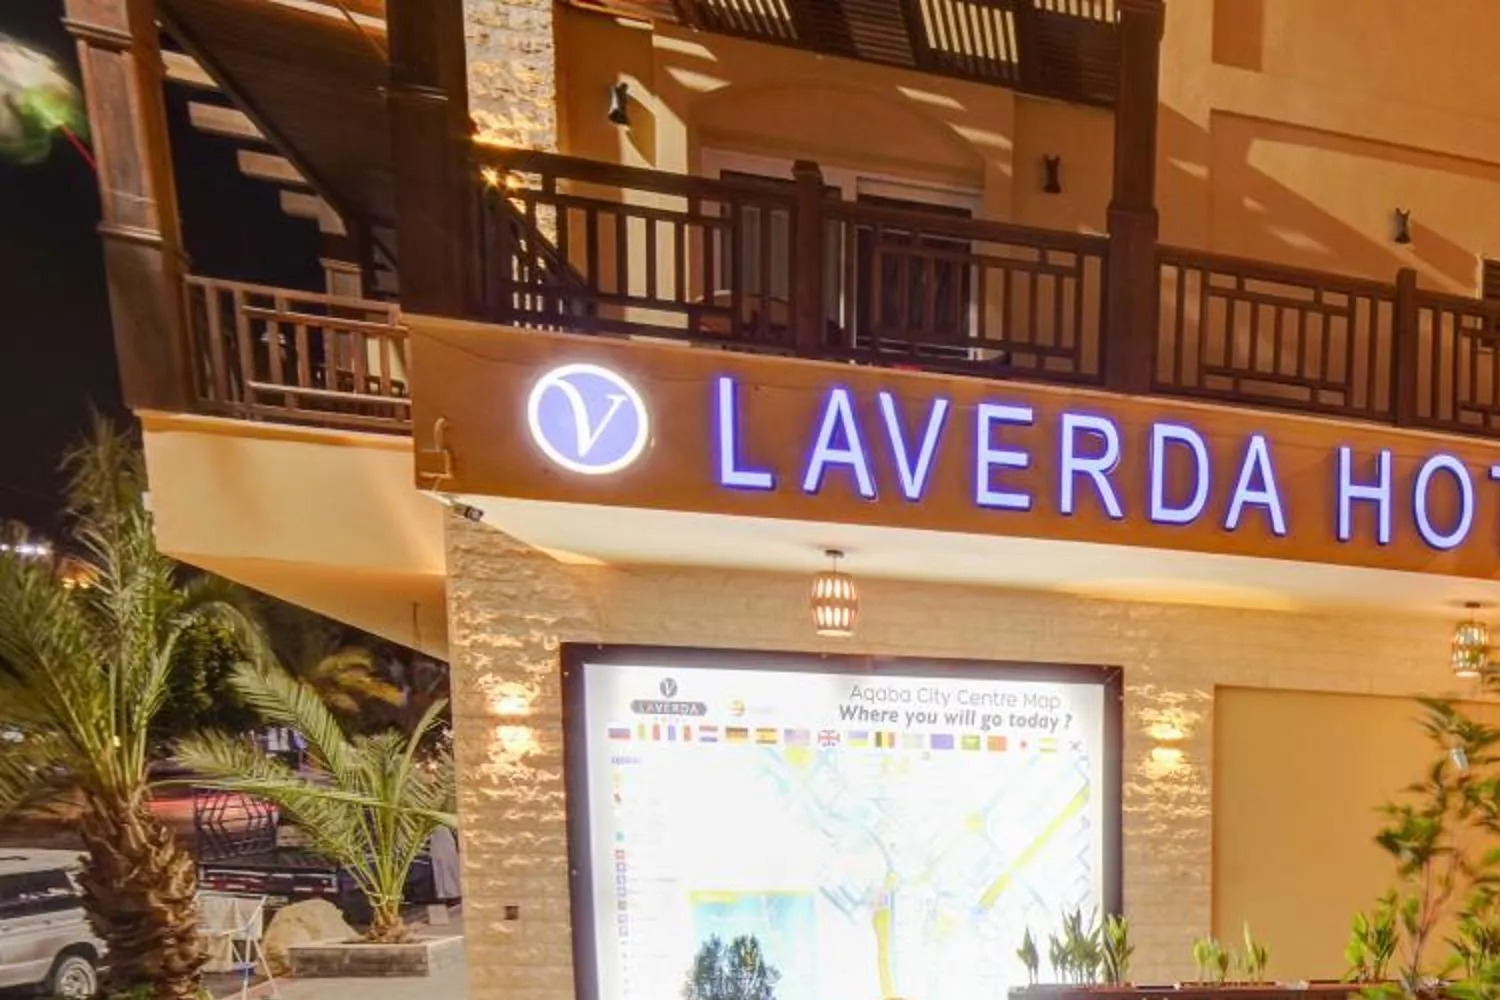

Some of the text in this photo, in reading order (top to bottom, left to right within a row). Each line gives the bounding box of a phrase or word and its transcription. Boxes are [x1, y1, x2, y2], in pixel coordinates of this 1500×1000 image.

[540, 375, 630, 460] V
[717, 376, 1287, 537] LAVERDA
[638, 702, 700, 716] LAVERDA
[850, 685, 1062, 715] Aqaba City Centre Map
[839, 703, 1073, 733] Where you will go today ?
